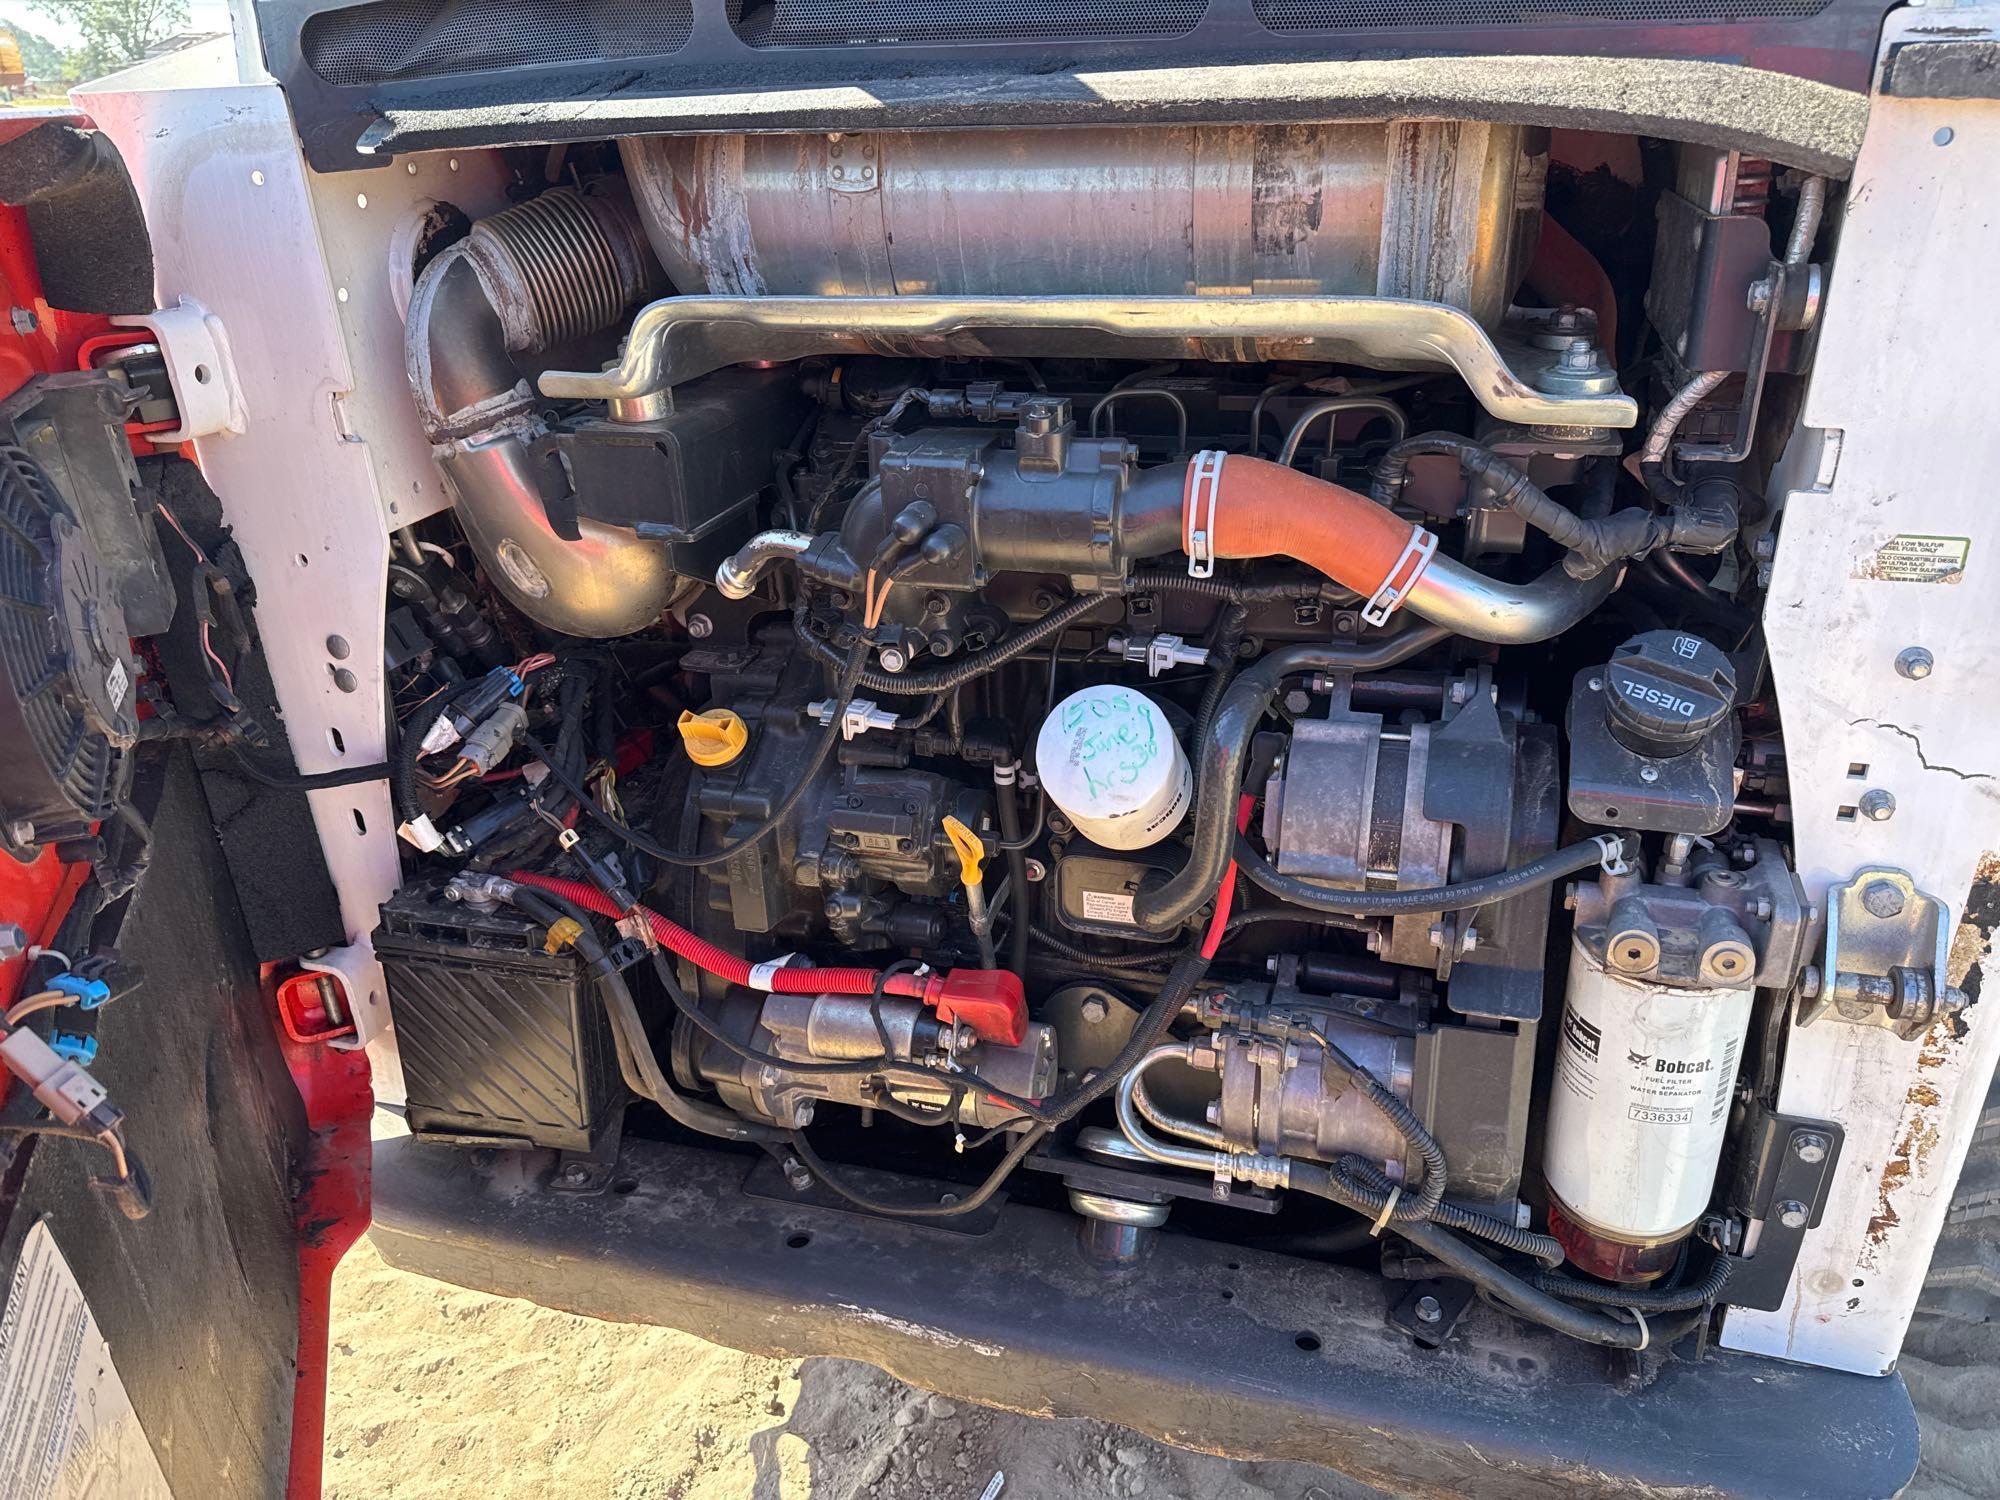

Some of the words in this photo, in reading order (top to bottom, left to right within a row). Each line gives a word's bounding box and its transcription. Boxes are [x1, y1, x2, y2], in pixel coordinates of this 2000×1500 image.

[1893, 555, 1936, 563] COMBUSTIBLE
[1622, 680, 1696, 717] DIESEL
[1402, 895, 1419, 903] SAE
[1497, 875, 1519, 887] MADE
[1520, 872, 1529, 880] IN
[1529, 864, 1545, 876] USA
[1581, 1047, 1599, 1064] PARTS
[1645, 1076, 1664, 1084] FUEL
[1630, 1085, 1657, 1095] WATER
[1658, 1089, 1702, 1097] SEPARATOR
[1632, 1109, 1689, 1123] 7336334
[45, 1378, 74, 1473] LUBRICATION
[69, 1311, 89, 1380] DIAGRAMS
